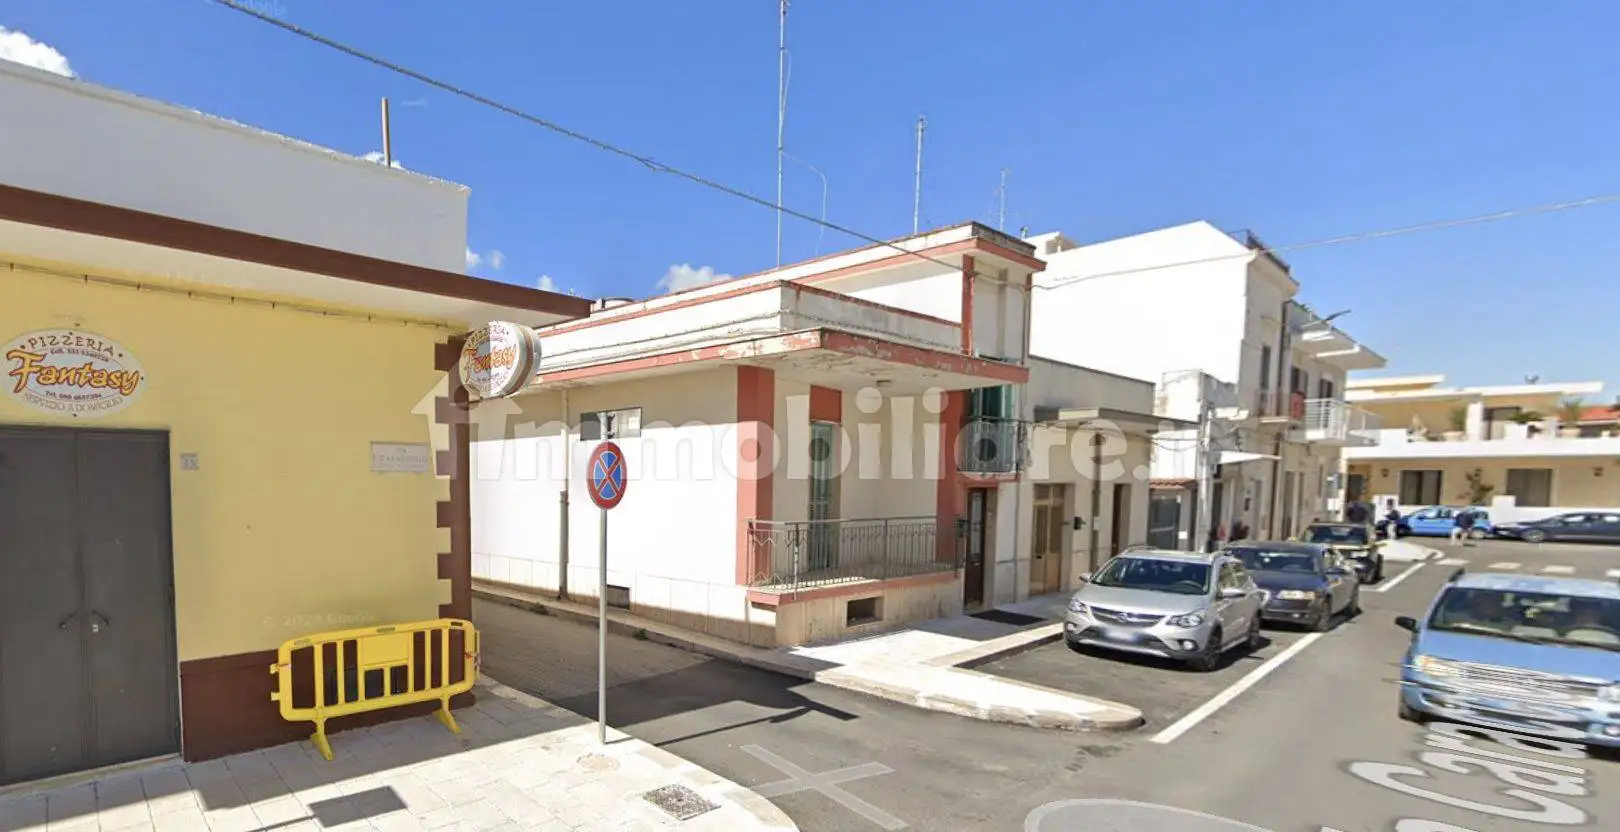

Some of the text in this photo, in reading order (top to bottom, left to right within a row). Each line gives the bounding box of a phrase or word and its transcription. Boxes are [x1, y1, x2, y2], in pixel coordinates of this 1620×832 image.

[28, 334, 115, 356] PIZZERIA
[462, 343, 517, 385] Fantasy
[6, 348, 140, 396] Fantasy
